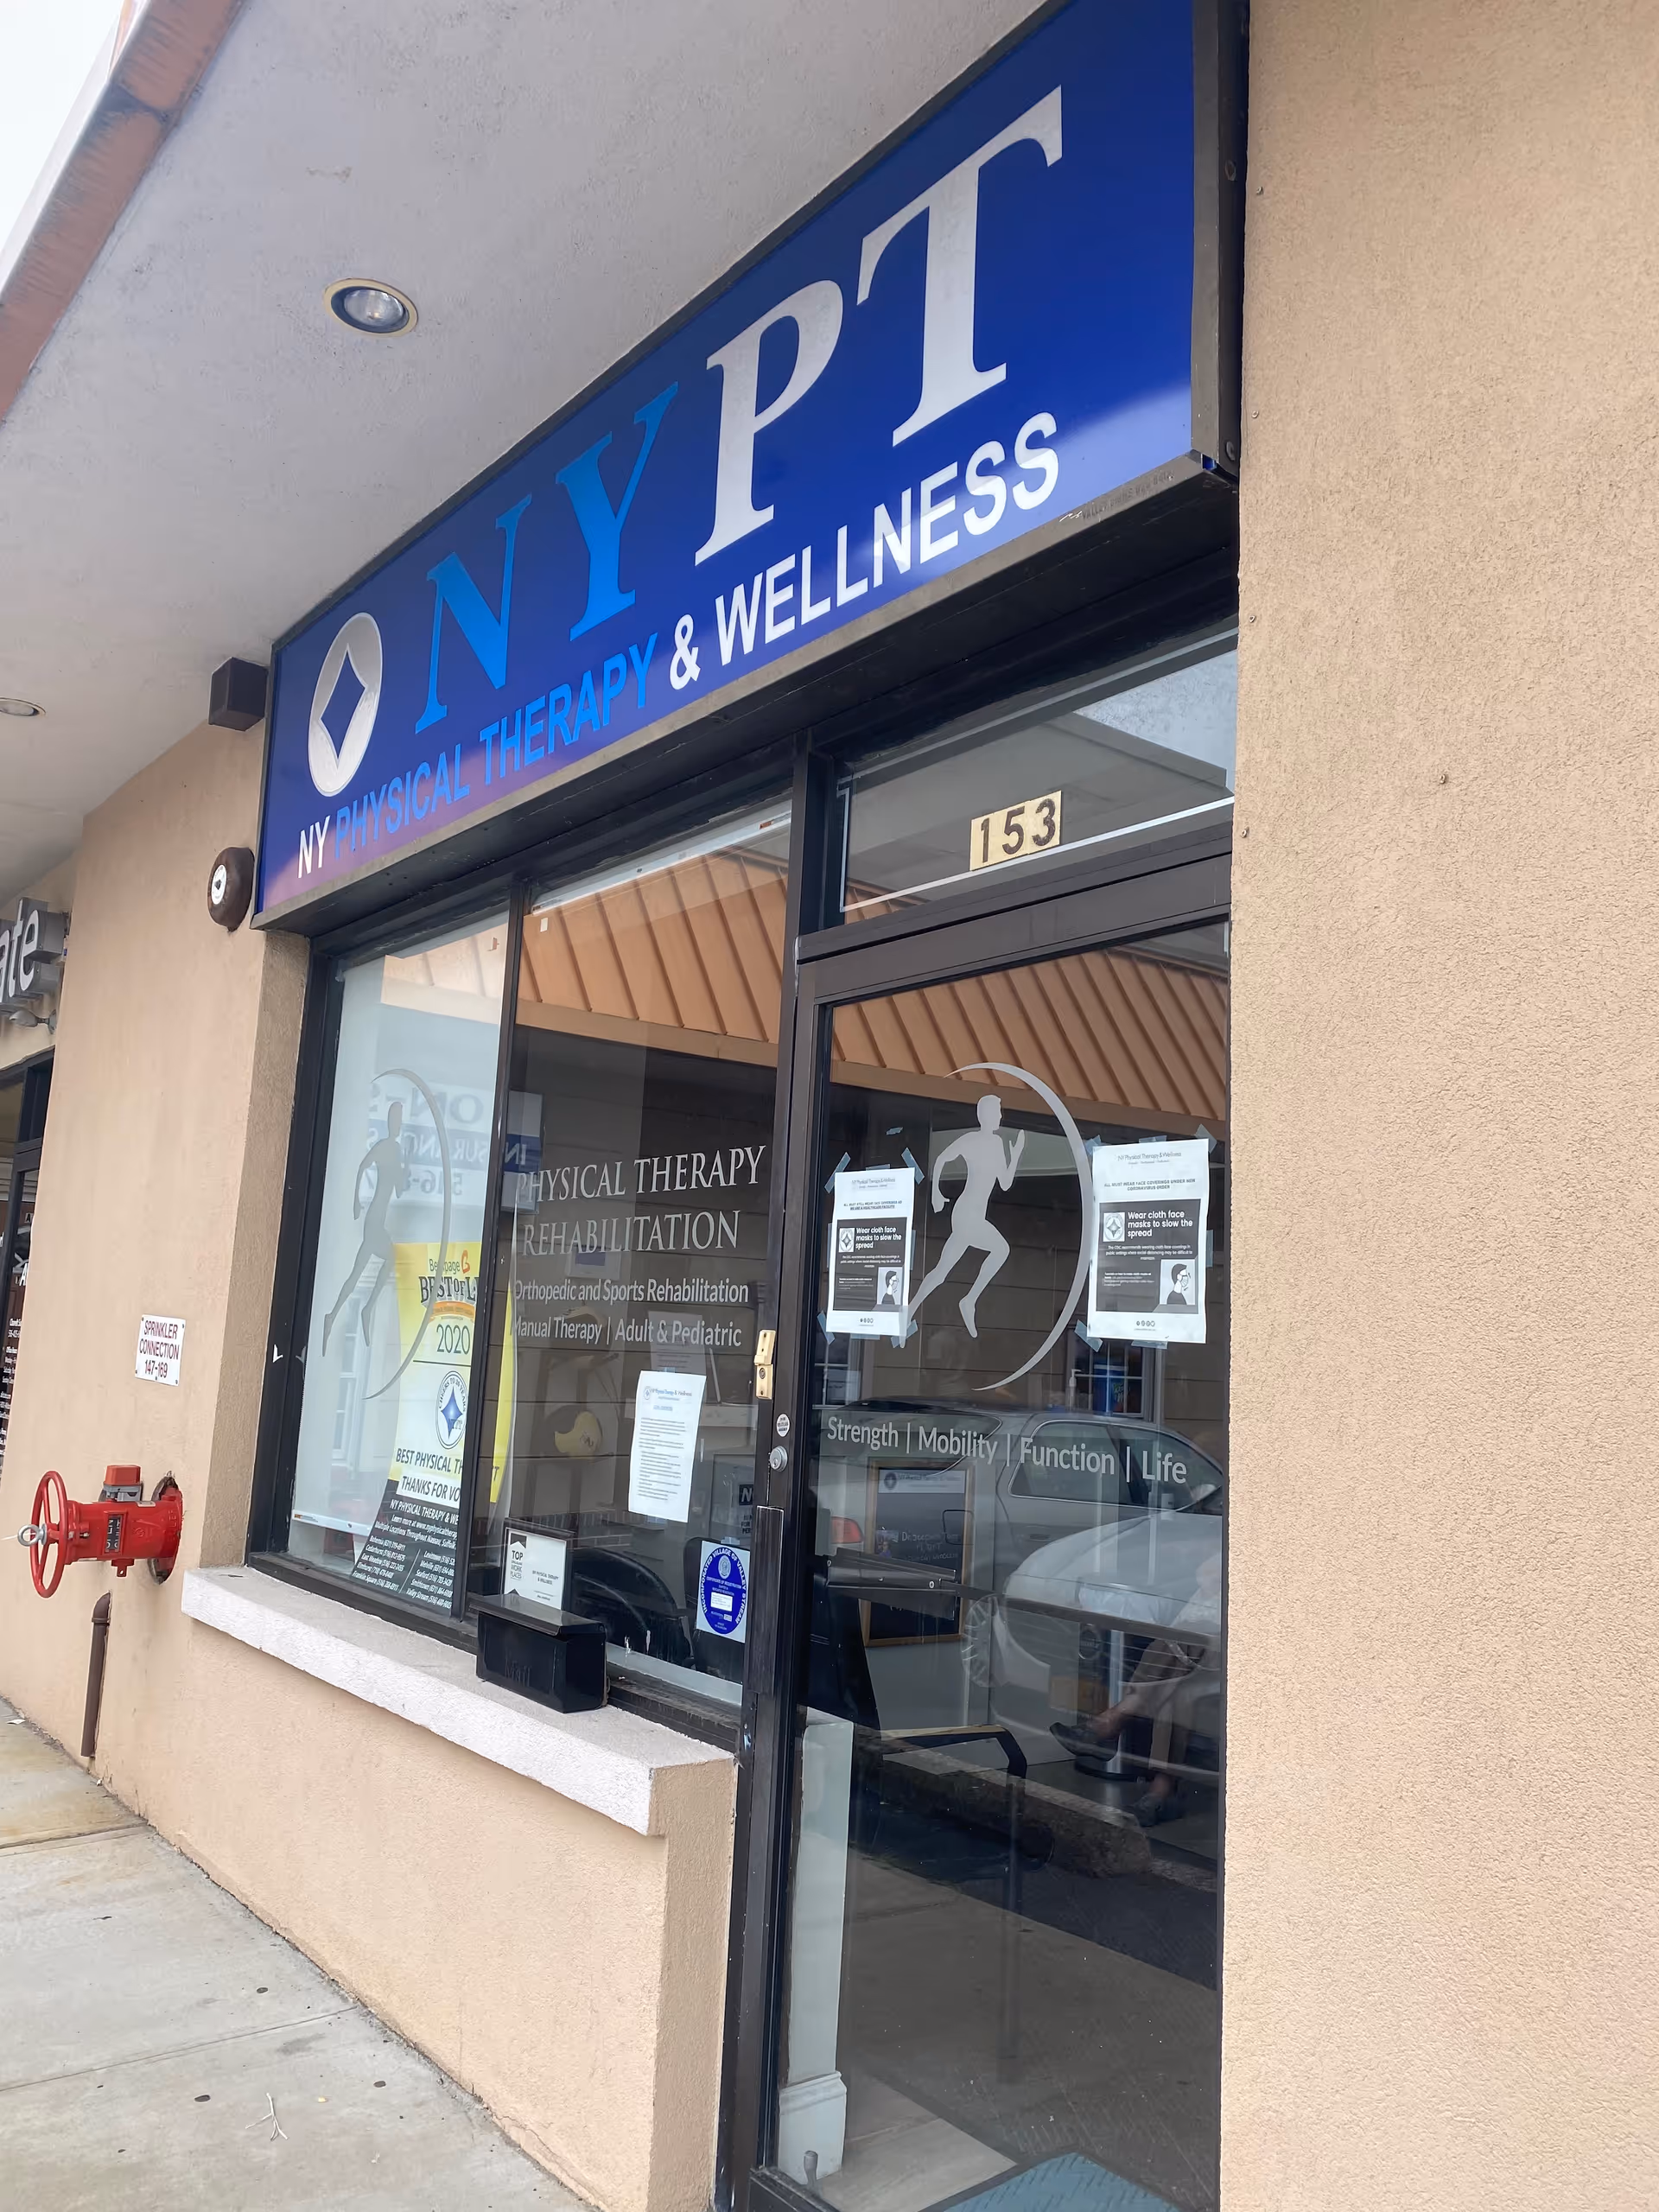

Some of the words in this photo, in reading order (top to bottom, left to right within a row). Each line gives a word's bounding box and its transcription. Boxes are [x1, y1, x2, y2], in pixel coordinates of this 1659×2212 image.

[416, 84, 1063, 734] NYPT
[297, 818, 330, 878] NY
[334, 748, 470, 861] PHYSICAL
[481, 633, 658, 786] THERAPY
[668, 613, 702, 690] &
[715, 411, 1060, 664] WELLNESS
[978, 795, 1057, 861] 153
[518, 1161, 626, 1204] PHYSICAL
[634, 1145, 766, 1194] THERAPY
[1128, 1220, 1151, 1229] masks
[1161, 1219, 1179, 1228] slow
[1168, 1210, 1185, 1218] face
[522, 1210, 741, 1256] REHABILITATION
[1128, 1229, 1153, 1239] spread
[516, 1280, 576, 1305] Orthopedic
[578, 1279, 601, 1300] and
[603, 1279, 645, 1306] Sports
[647, 1278, 749, 1304] Rehabilitation
[144, 1319, 178, 1339] SPRINKLER
[436, 1324, 471, 1355] 2020
[511, 1318, 551, 1338] Manual
[554, 1316, 602, 1344] Therapy
[615, 1319, 654, 1343] Adult
[658, 1320, 669, 1344] &
[671, 1319, 742, 1347] Pediatric
[139, 1338, 180, 1360] CONNECTION
[145, 1359, 168, 1378] 147-169
[396, 1448, 415, 1465] BEST
[415, 1452, 451, 1472] PHYSICAL
[827, 1416, 899, 1451] Strength
[918, 1426, 998, 1465] Mobility
[1021, 1438, 1116, 1476] Function
[1142, 1451, 1187, 1484] Life
[401, 1476, 432, 1496] THANKS
[431, 1482, 448, 1500] FOR
[390, 1499, 397, 1510] NY
[397, 1501, 422, 1516] PHYSICAL
[422, 1507, 445, 1521] THERAPY
[512, 1549, 524, 1560] TOP
[712, 1548, 731, 1558] VILLAGE
[731, 1553, 738, 1561] OF
[736, 1560, 747, 1591] VALLEY
